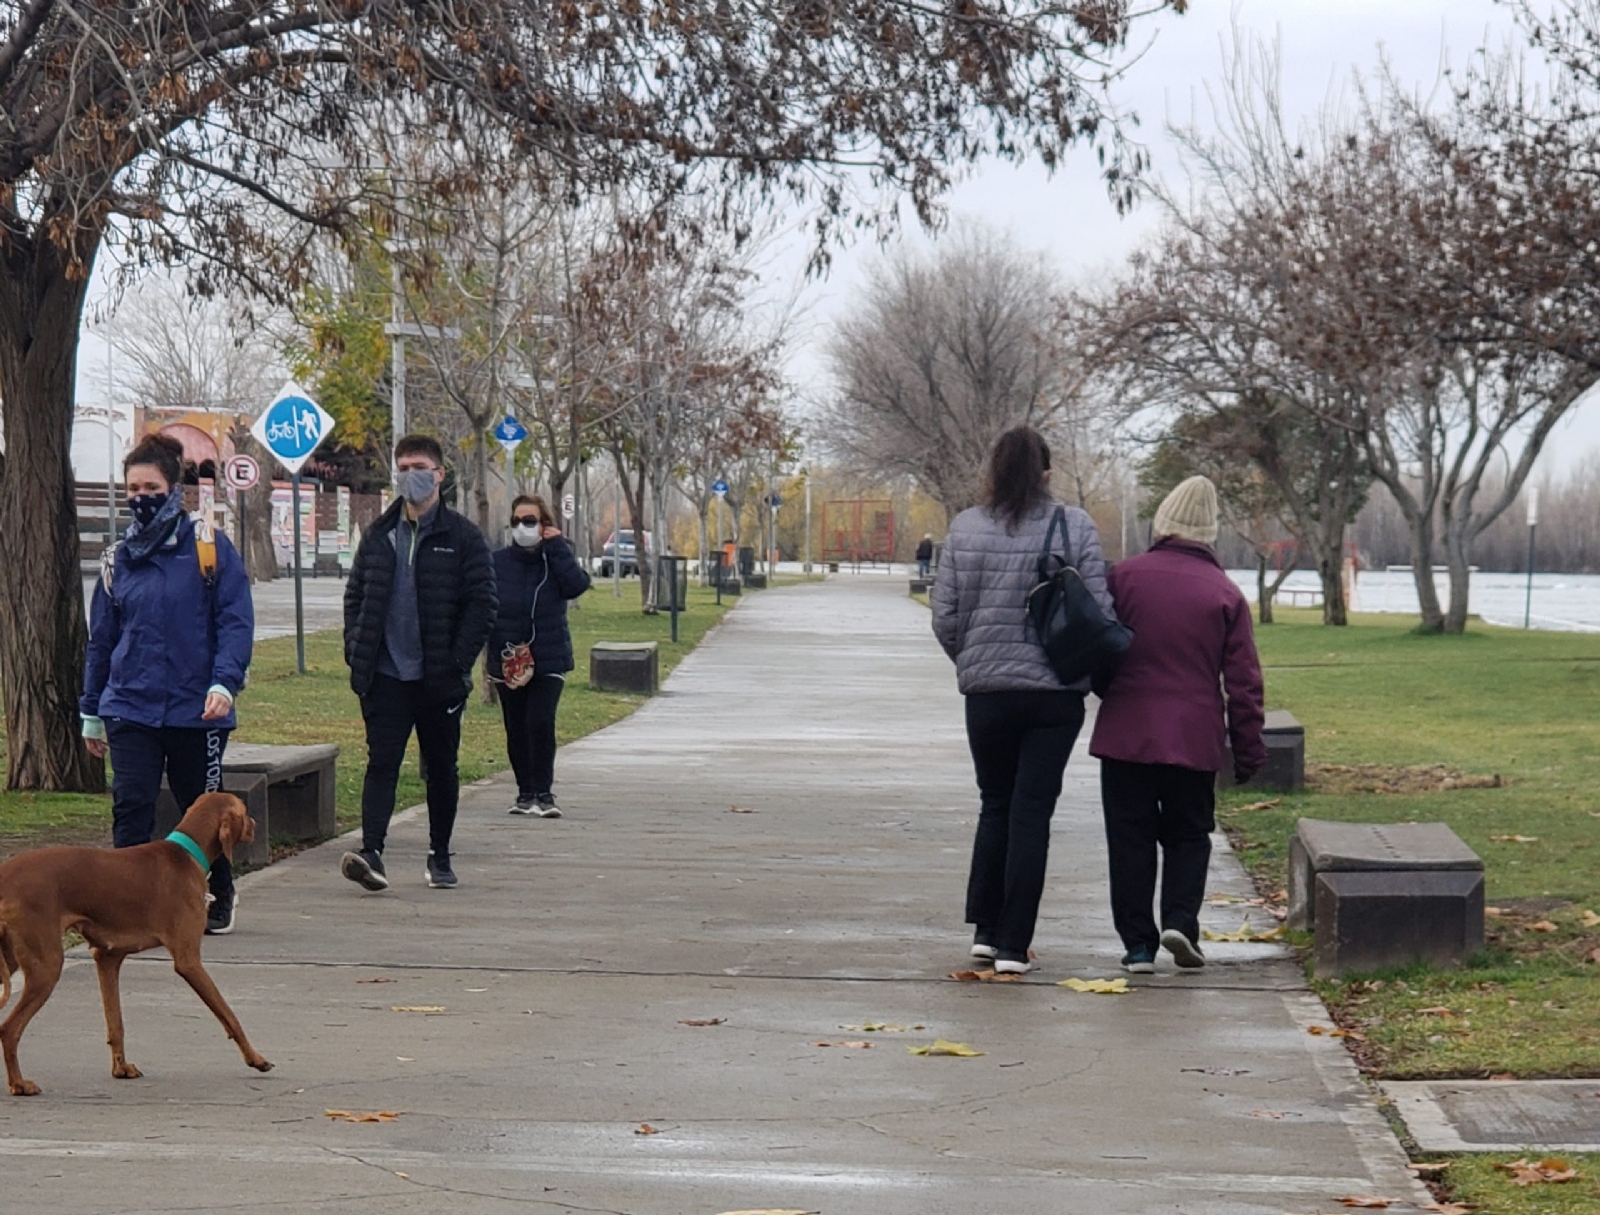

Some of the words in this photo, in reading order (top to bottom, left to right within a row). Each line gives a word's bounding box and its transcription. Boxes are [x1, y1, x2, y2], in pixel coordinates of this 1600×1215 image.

[236, 464, 249, 480] E
[565, 501, 573, 511] E
[206, 728, 220, 757] LOS
